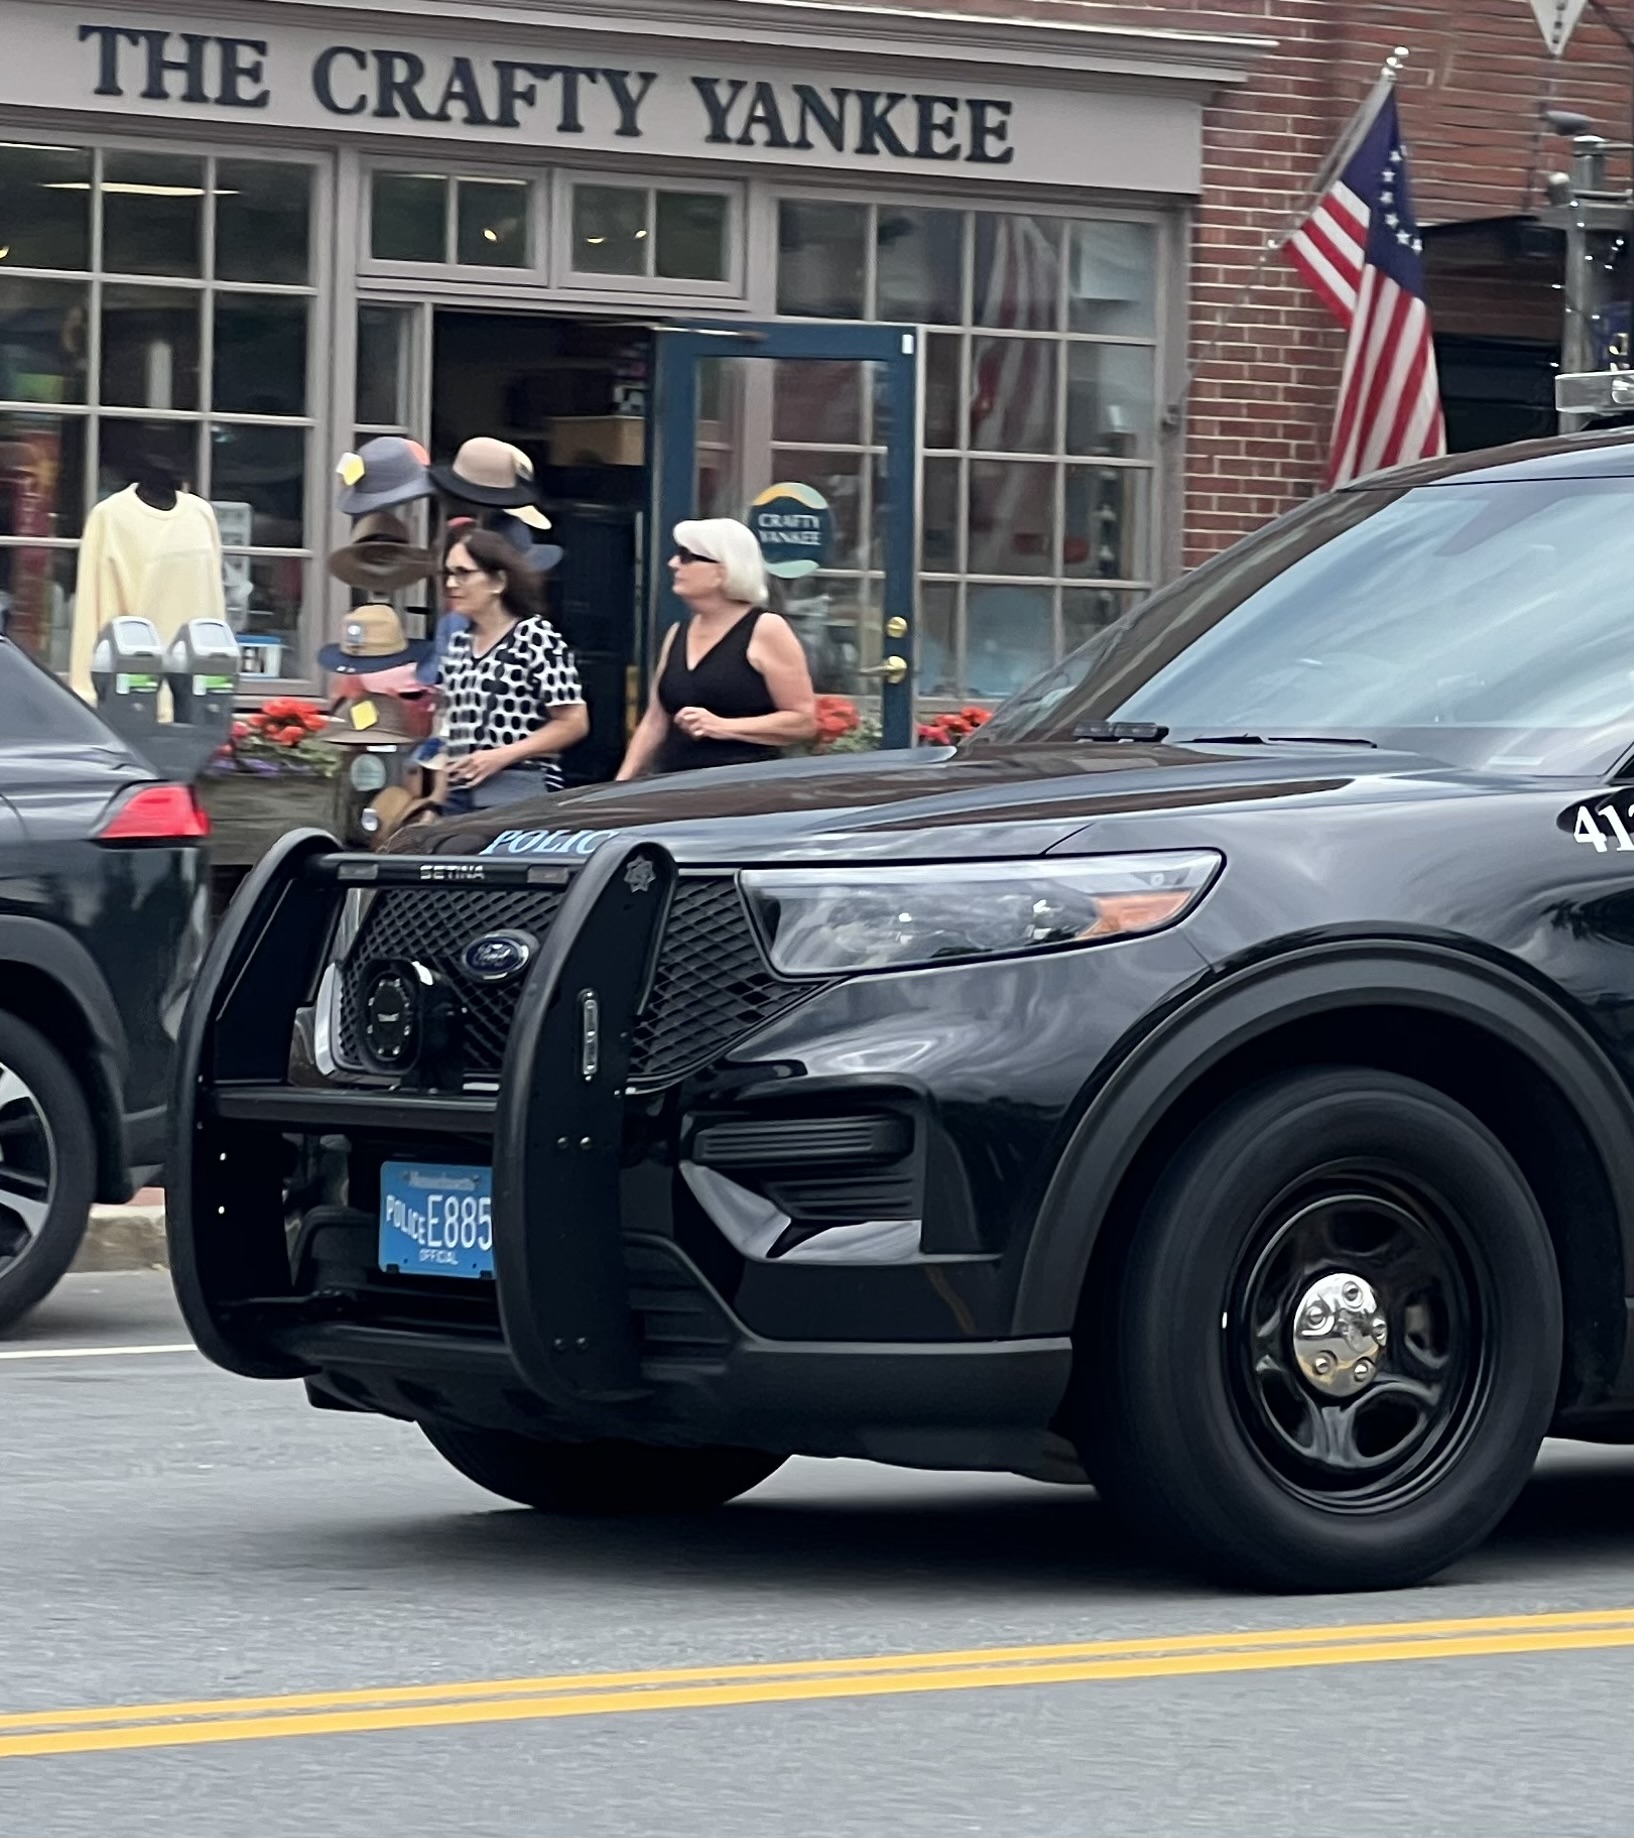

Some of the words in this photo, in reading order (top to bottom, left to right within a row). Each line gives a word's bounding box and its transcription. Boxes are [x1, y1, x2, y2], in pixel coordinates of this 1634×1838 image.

[78, 24, 271, 108] THE
[311, 45, 658, 137] CRAFTY
[691, 76, 1015, 164] YANKEE
[758, 513, 820, 528] CRAFTY
[758, 530, 822, 546] YANKEE
[479, 829, 620, 856] POLIC
[420, 865, 486, 880] SETINA
[385, 1194, 427, 1245] POLICE
[427, 1194, 493, 1251] E885
